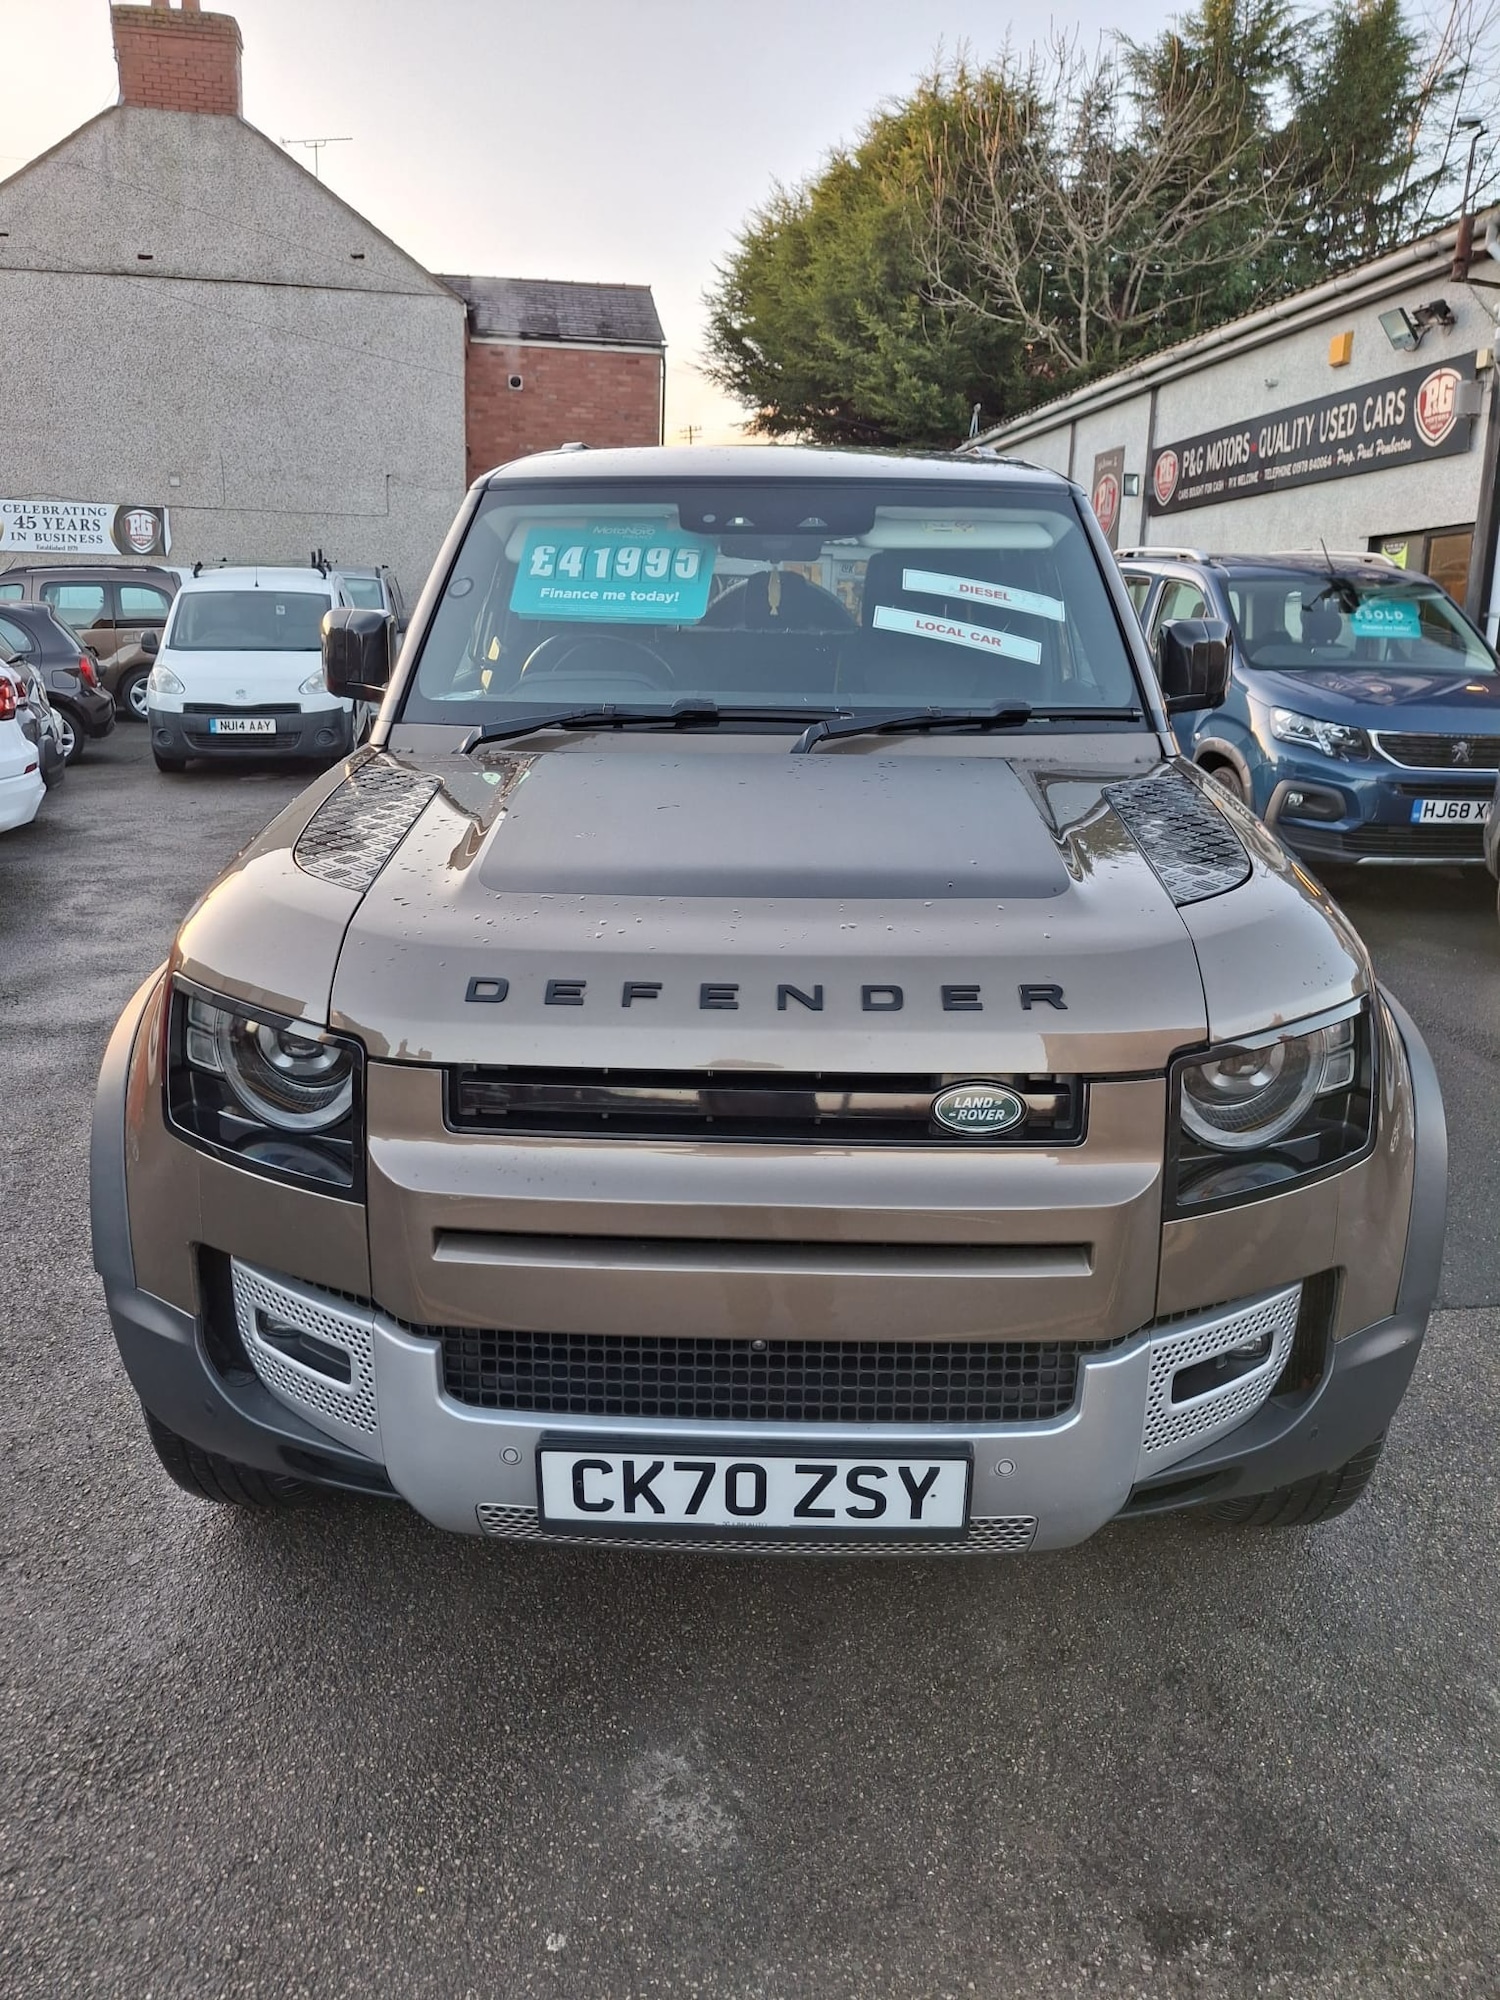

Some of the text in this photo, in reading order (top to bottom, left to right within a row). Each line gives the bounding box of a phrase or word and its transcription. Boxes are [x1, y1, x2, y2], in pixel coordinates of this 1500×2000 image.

[1182, 387, 1407, 479] P&G MOTORS QUALITY USED CARS
[1264, 463, 1293, 480] TELEPHONE
[2, 504, 107, 517] CELEBRATING
[13, 515, 101, 531] 45 YEARS
[11, 532, 103, 544] IN BUSINESS
[530, 545, 700, 579] £41995
[540, 587, 680, 604] Finance me today!
[959, 583, 1012, 602] DIESEL
[915, 619, 1002, 647] LOCAL CAR
[220, 720, 271, 731] NU14 AAY
[1423, 801, 1471, 819] HJ68
[465, 976, 1069, 1012] DEFENDER
[953, 1097, 992, 1110] LAND
[957, 1109, 1006, 1121] ROVER
[571, 1458, 941, 1520] CK70 ZSY
